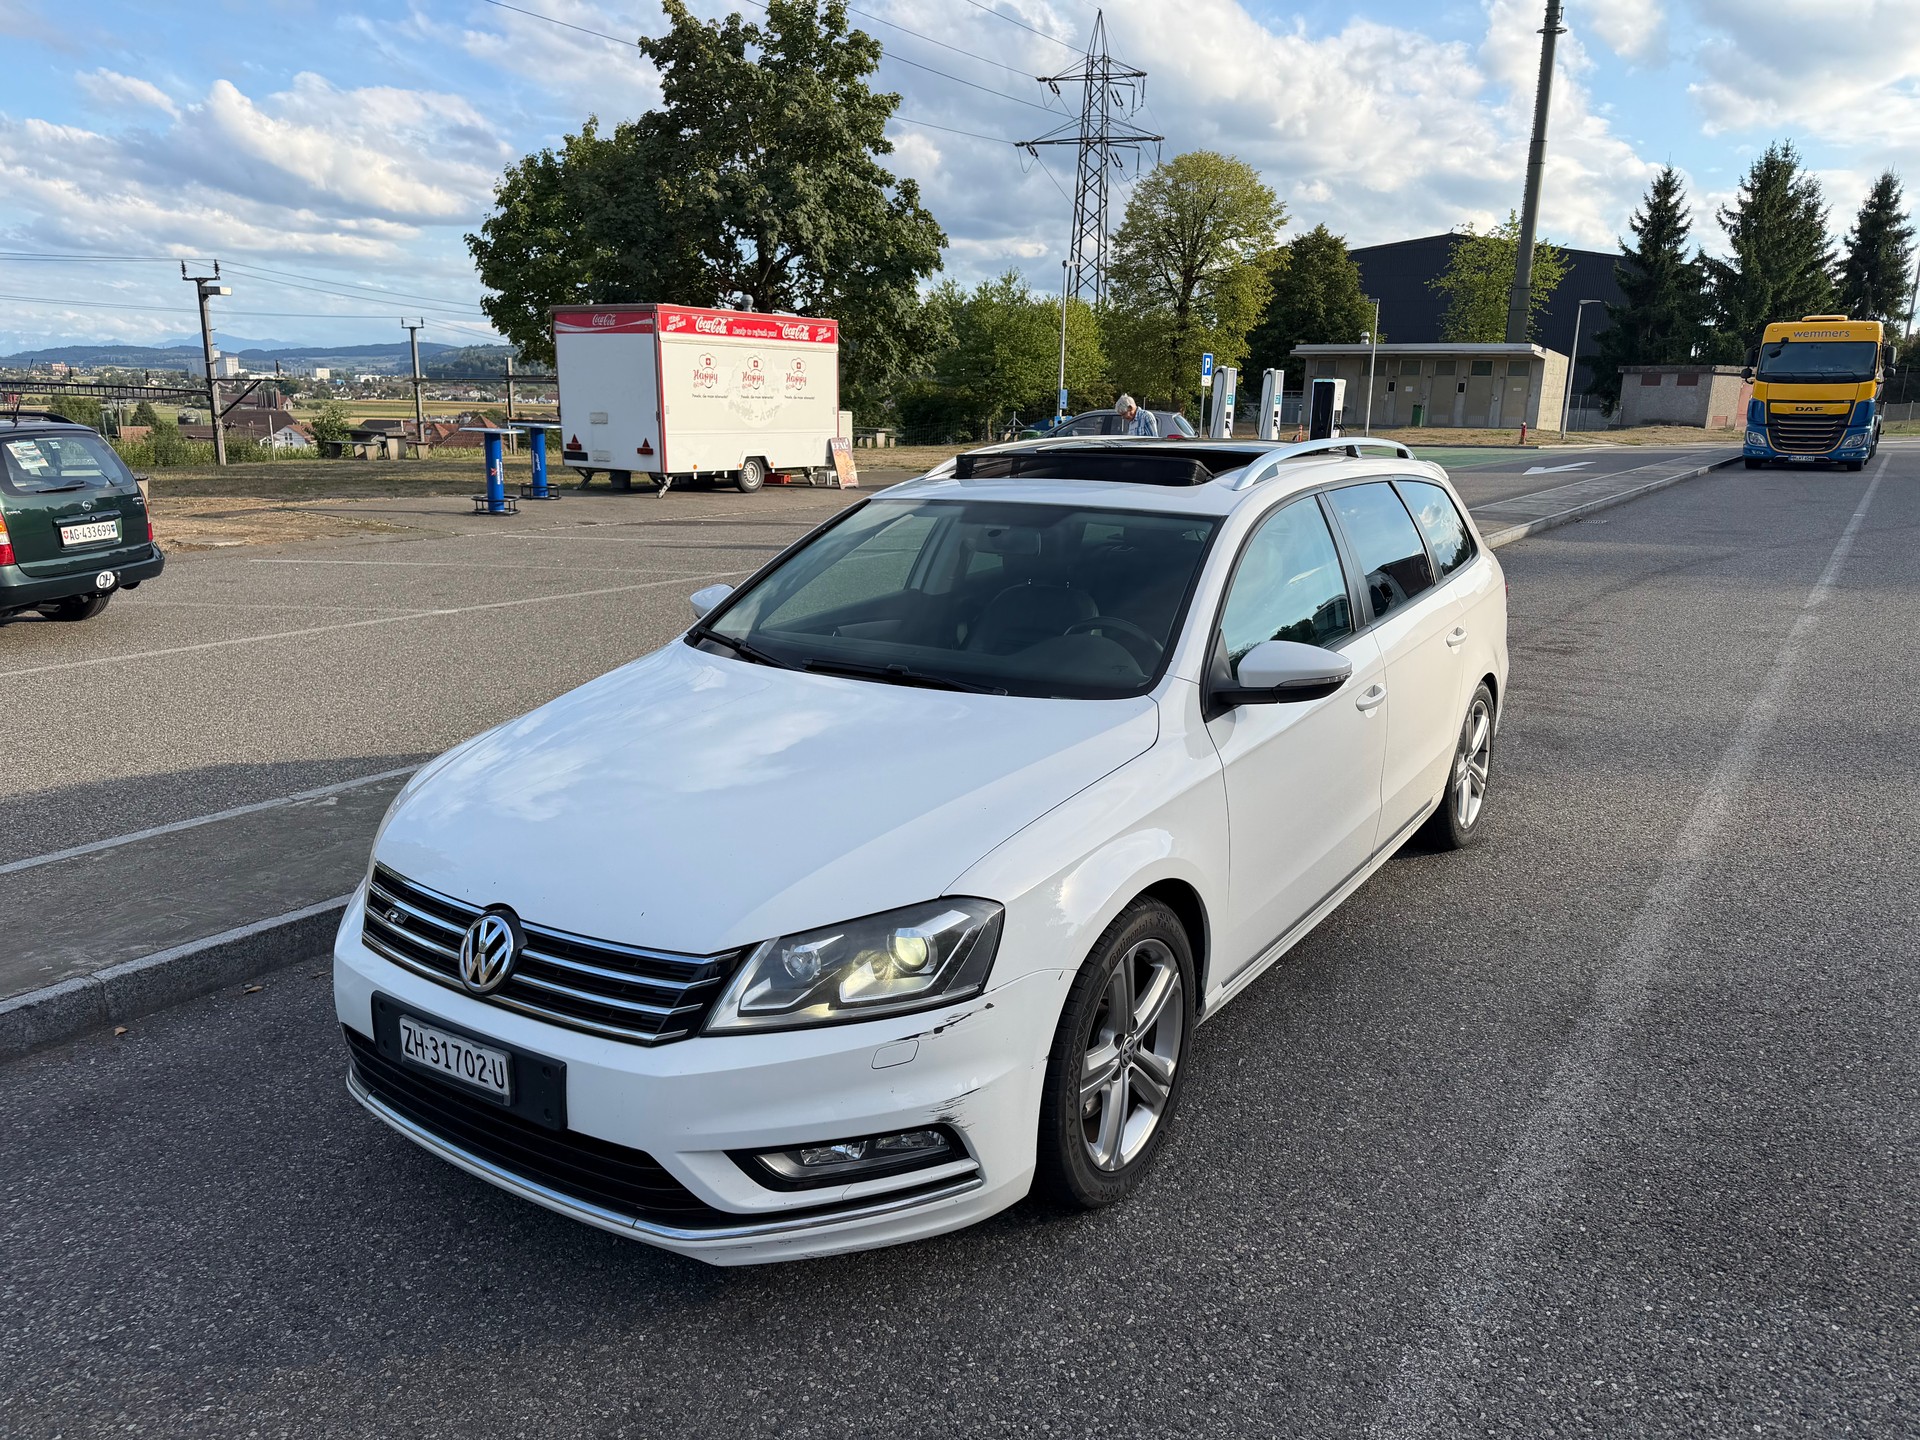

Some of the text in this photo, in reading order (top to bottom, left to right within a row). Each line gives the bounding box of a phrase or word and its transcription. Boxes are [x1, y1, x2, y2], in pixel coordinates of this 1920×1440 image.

[1793, 329, 1850, 338] wemmers
[1204, 358, 1210, 374] P
[693, 369, 718, 384] Happy
[742, 371, 765, 385] Happy
[785, 372, 807, 387] Happy
[98, 574, 111, 587] CH
